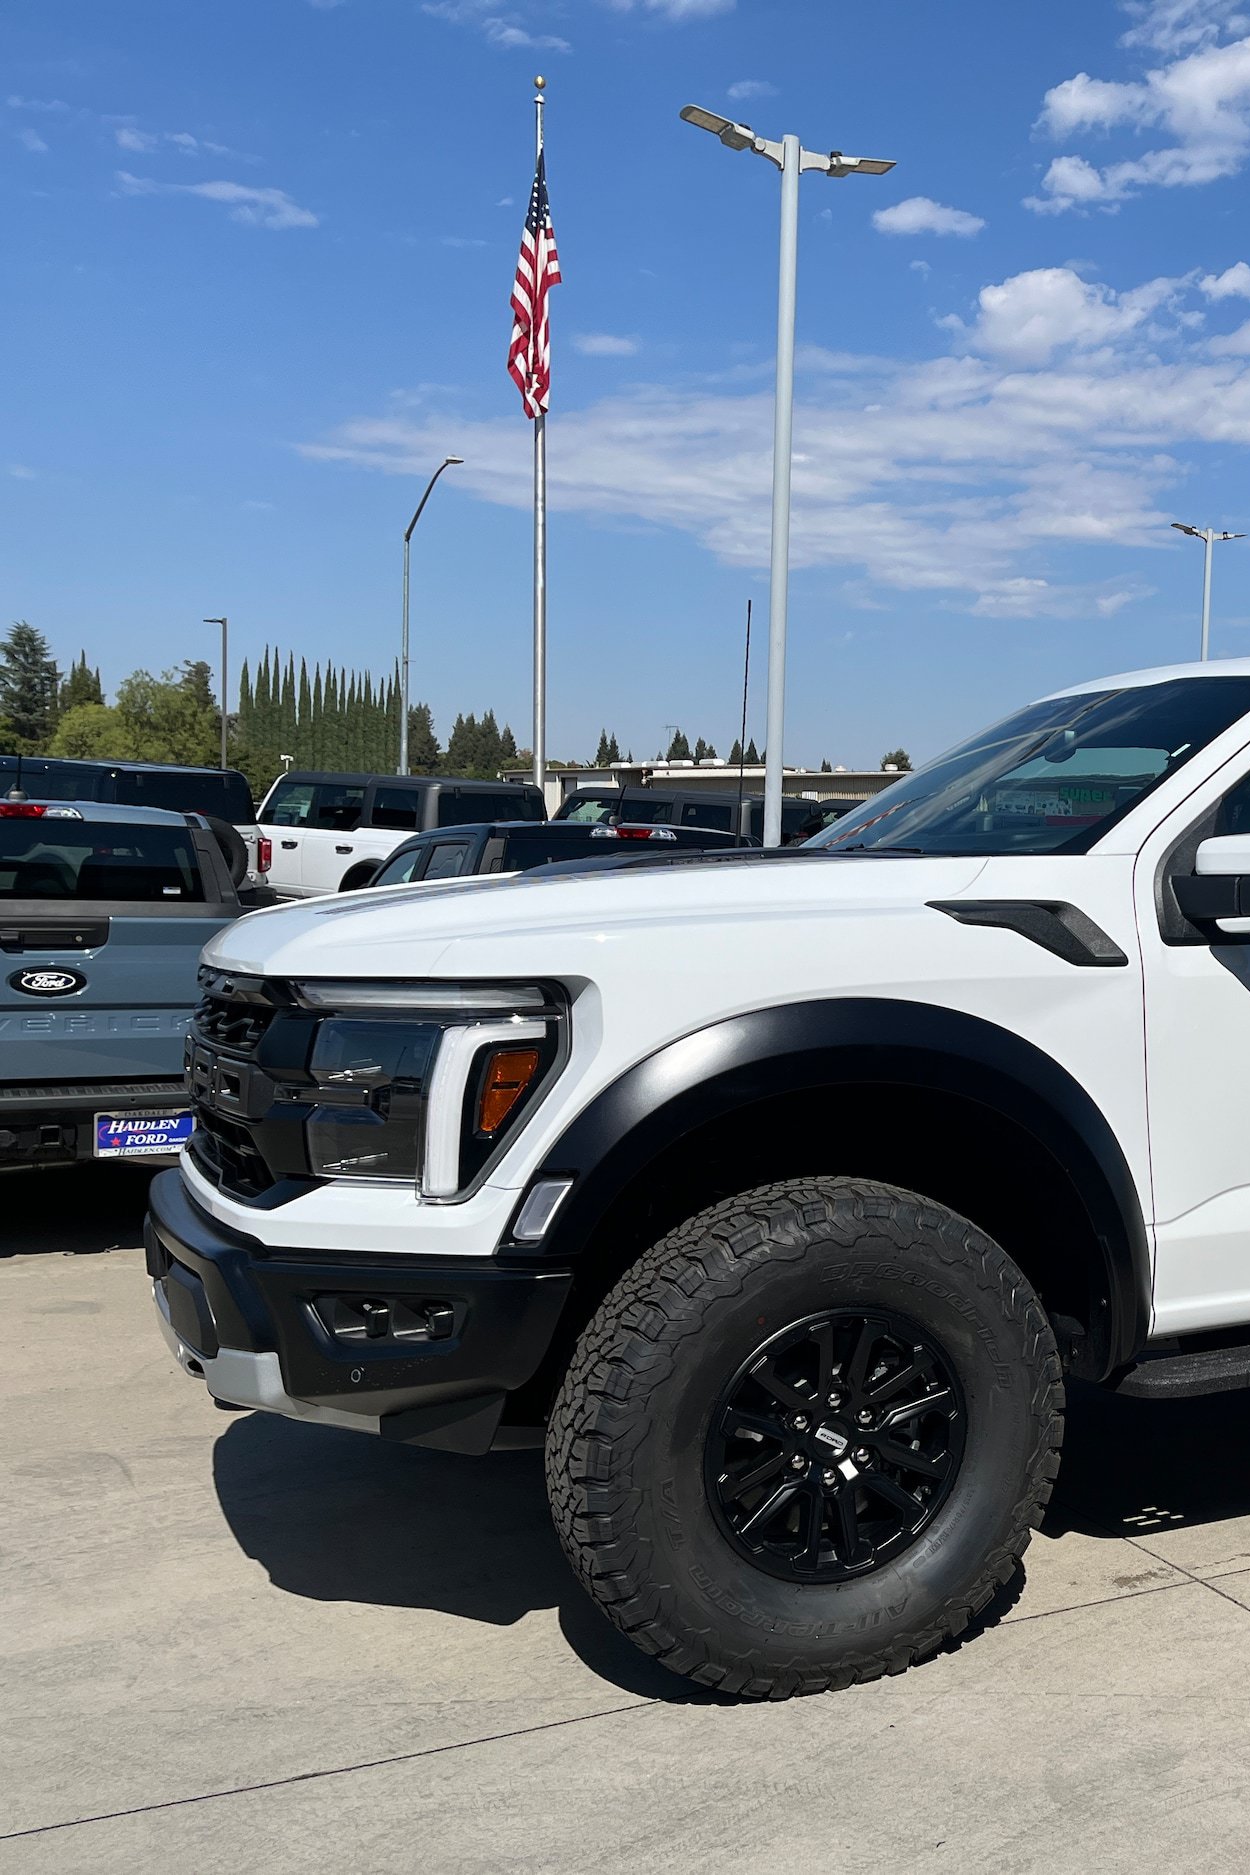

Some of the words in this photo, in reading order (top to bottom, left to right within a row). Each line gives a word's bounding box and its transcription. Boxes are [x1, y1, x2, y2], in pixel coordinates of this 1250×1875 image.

[31, 975, 65, 988] Ford
[107, 1119, 180, 1134] HAIDLEN
[125, 1133, 168, 1145] FORD
